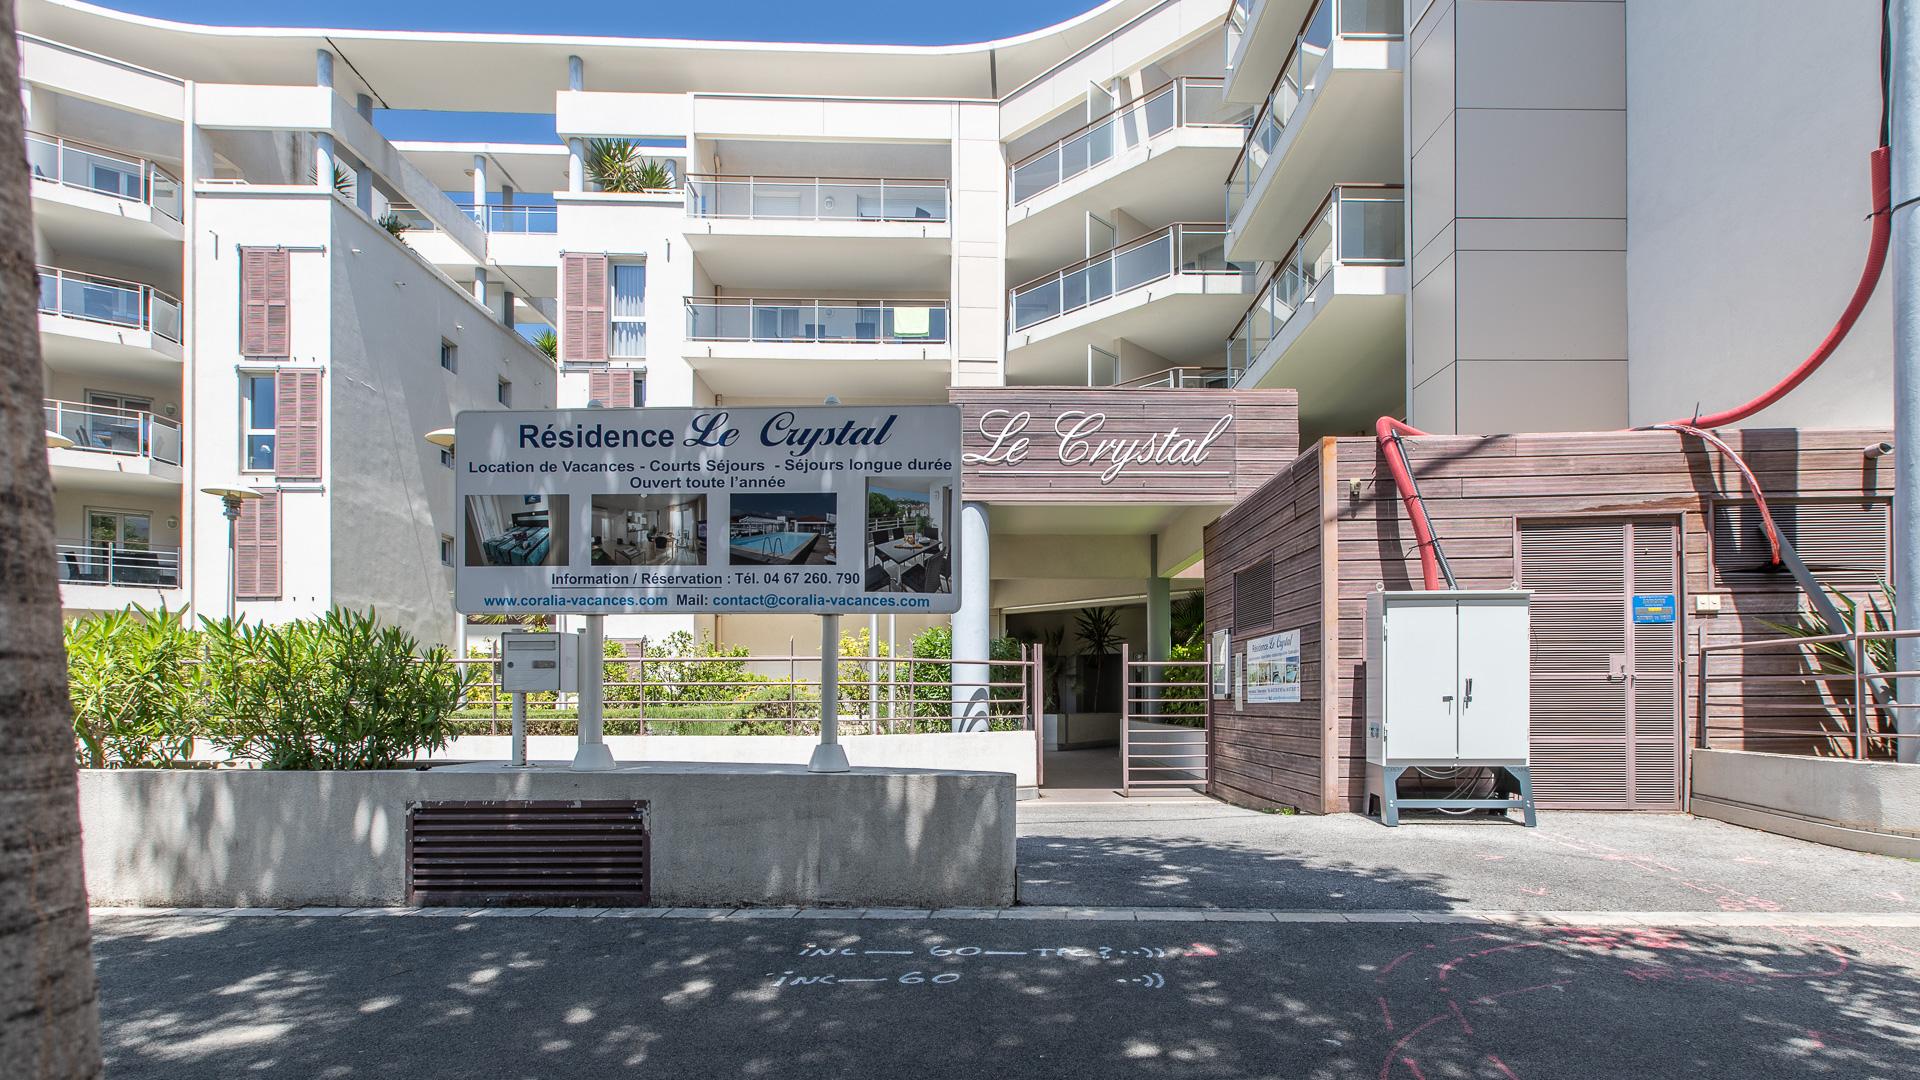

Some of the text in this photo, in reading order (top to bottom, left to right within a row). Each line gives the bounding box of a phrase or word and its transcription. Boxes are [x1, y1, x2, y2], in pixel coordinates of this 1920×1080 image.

[519, 411, 898, 457] Résidence Le Crystal
[961, 409, 1234, 483] Le Crystal
[468, 460, 534, 473] Location
[539, 460, 558, 473] de
[562, 460, 635, 473] Vacances
[649, 459, 701, 473] Courts
[706, 458, 765, 475] Séjours
[784, 457, 844, 474] Séjours
[849, 457, 902, 474] longue
[907, 456, 953, 471] durée
[629, 475, 785, 489] Ouvert toute l’année
[551, 573, 629, 585] Information
[641, 572, 722, 585] Réservation
[735, 572, 759, 584] Tél.
[763, 572, 779, 584] 04
[783, 572, 799, 584] 67
[803, 572, 832, 584] 260.
[836, 572, 860, 584] 790
[484, 593, 930, 609] www.coralia-vacances.com Mail: contact@coralia-vacances.com
[899, 971, 960, 984] 60
